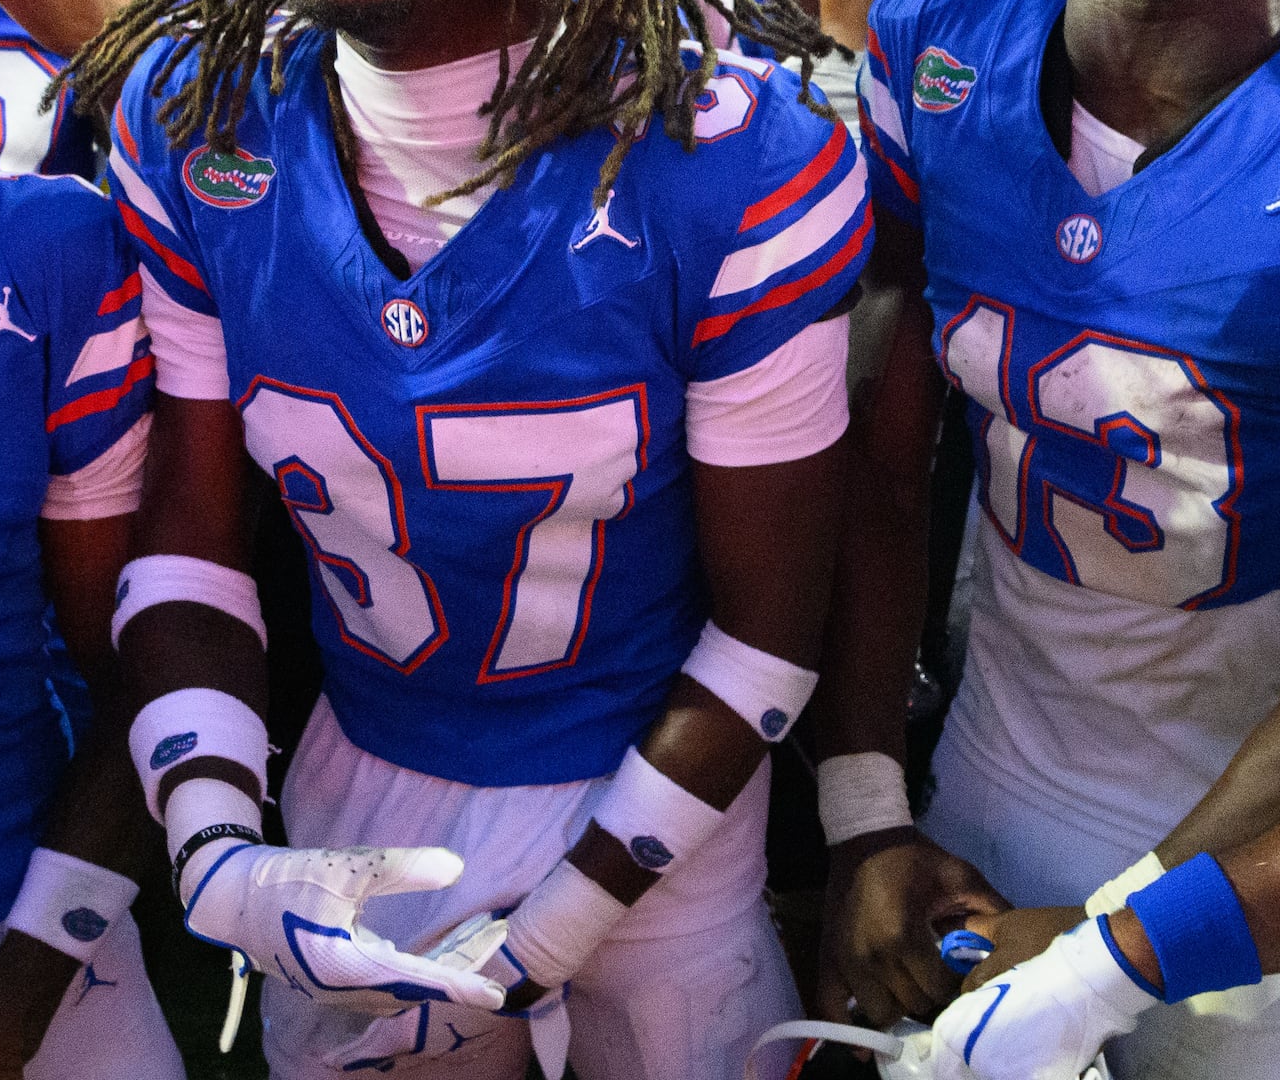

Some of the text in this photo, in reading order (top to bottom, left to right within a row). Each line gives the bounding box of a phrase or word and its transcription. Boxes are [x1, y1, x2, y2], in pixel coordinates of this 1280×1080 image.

[1057, 215, 1101, 262] SEC
[384, 301, 424, 344] SEC
[941, 294, 1241, 612] 13
